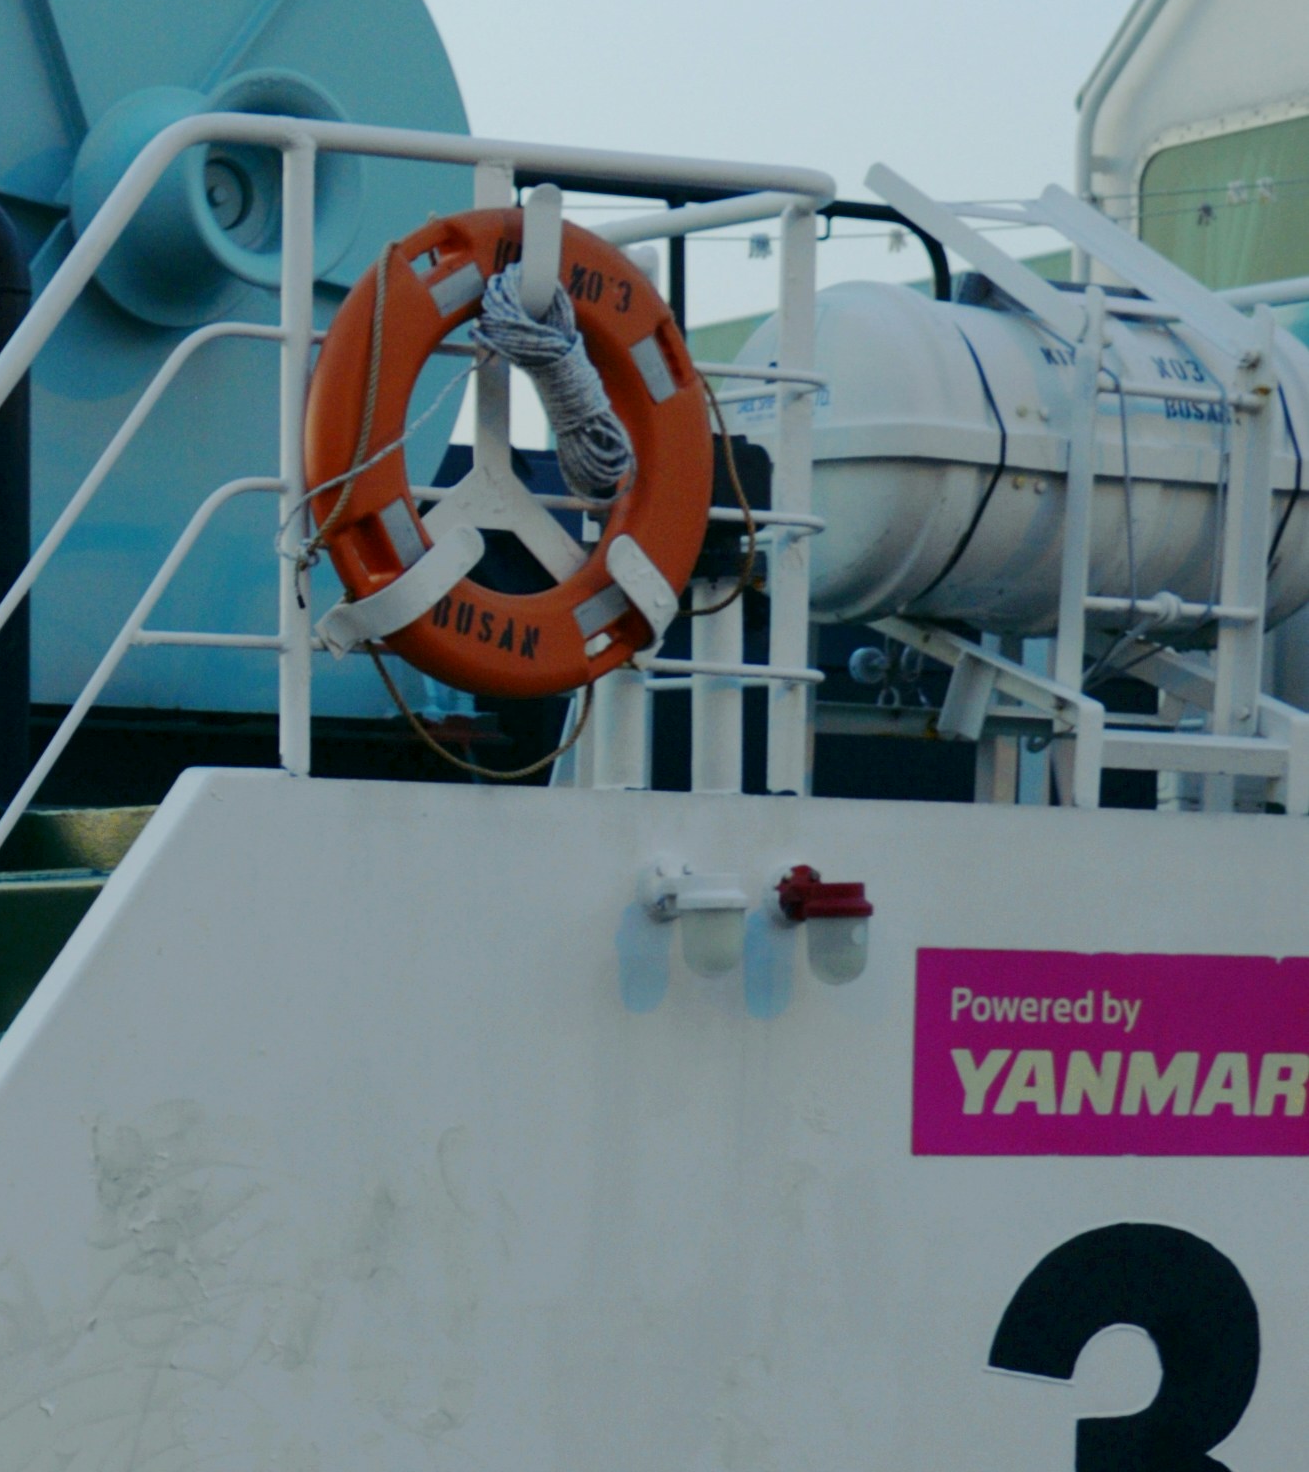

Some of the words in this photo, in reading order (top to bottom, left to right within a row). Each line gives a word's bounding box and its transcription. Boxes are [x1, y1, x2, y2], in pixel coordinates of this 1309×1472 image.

[433, 593, 540, 660] BUSAN
[950, 987, 1094, 1024] Powered
[1102, 989, 1141, 1033] by
[949, 1048, 1309, 1117] YANMAR
